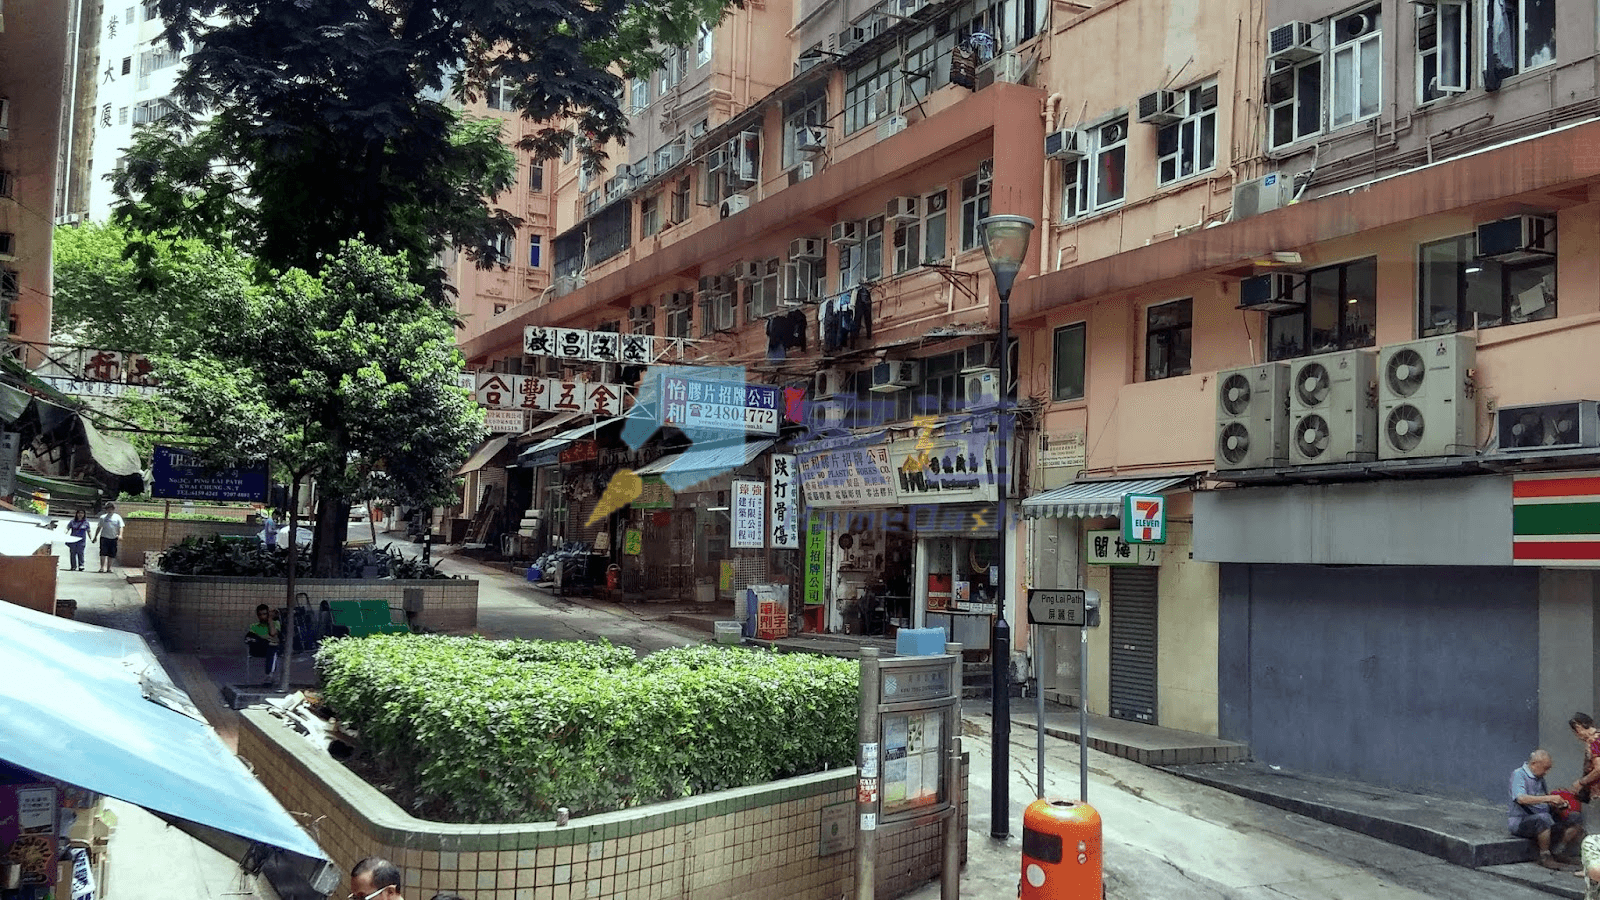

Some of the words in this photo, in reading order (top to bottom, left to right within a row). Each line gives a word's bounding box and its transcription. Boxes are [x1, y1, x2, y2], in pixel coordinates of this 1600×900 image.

[479, 375, 618, 415] 合豐五金
[666, 379, 686, 423] 怡和
[688, 381, 775, 408] 膠片招牌公司
[705, 404, 773, 424] 24804772
[828, 468, 853, 478] PLASTIC
[856, 467, 878, 475] WORKS
[738, 497, 747, 540] 建築工程
[747, 497, 756, 540] 有限公司
[774, 457, 789, 545] 跌打骨傷
[1136, 501, 1159, 539] 7
[1041, 594, 1054, 604] Ping
[1055, 594, 1065, 603] Lai
[1067, 594, 1082, 604] Path
